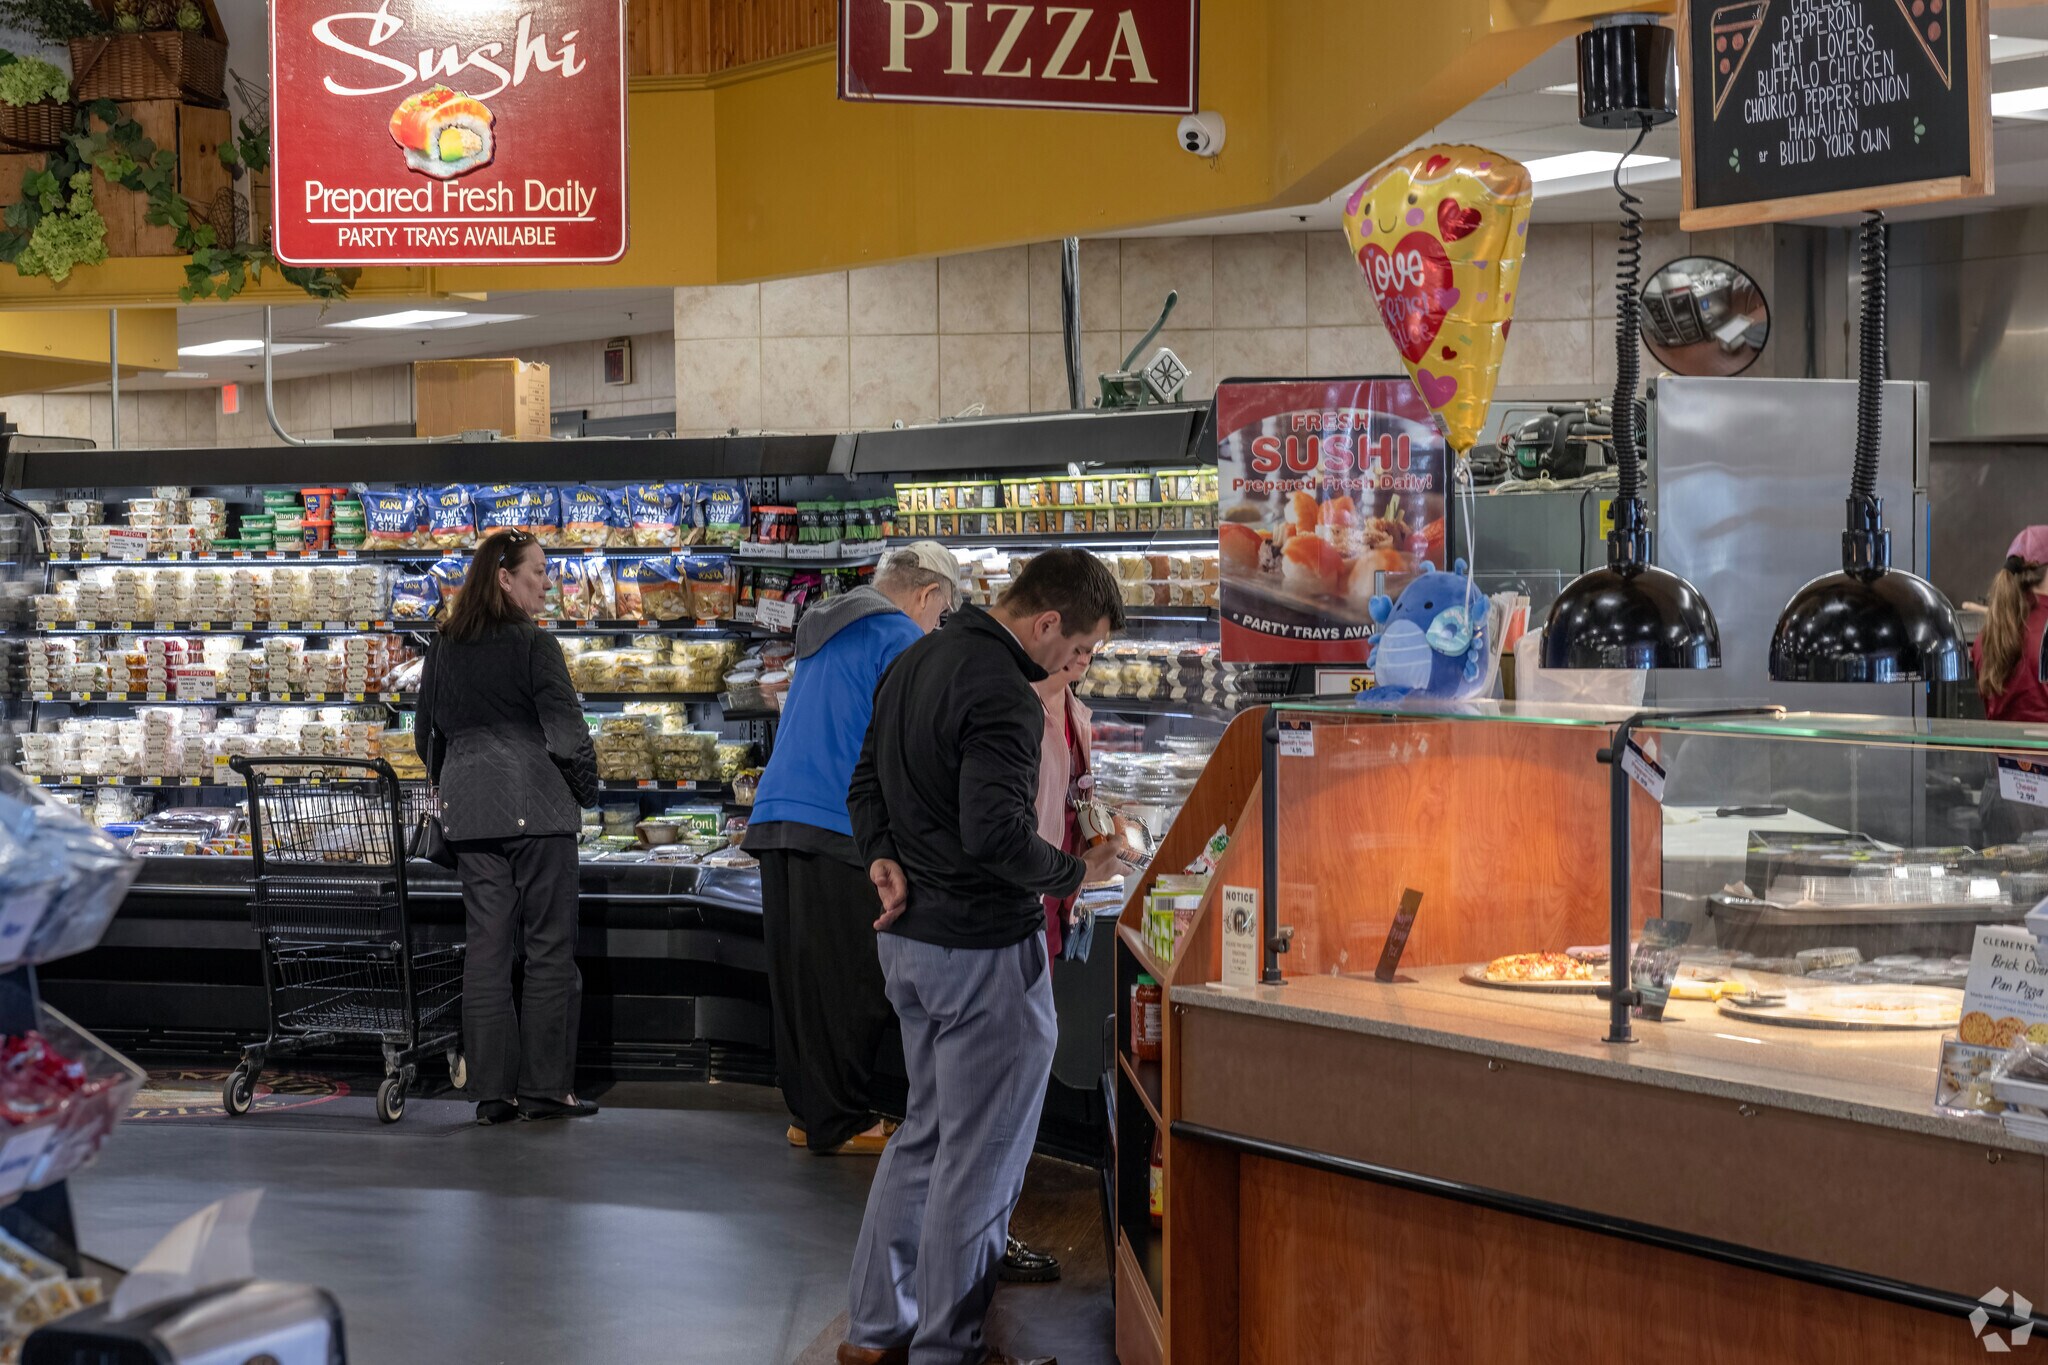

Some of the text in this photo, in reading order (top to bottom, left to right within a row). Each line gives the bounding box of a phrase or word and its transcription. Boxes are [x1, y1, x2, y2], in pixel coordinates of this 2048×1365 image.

[1782, 2, 1862, 41] PEPPERONI
[311, 0, 587, 100] Sushi
[882, 0, 1158, 84] PIZZA
[1772, 24, 1875, 68] MEAT LOVERS
[1758, 49, 1895, 97] BUFFALO CHICKEN
[1744, 91, 1797, 124] CHOURICO
[1805, 84, 1853, 115] PEPPER
[1863, 73, 1910, 107] ONION
[1789, 108, 1859, 141] HAWAIIAN
[1780, 139, 1816, 167] BUILD
[1822, 132, 1855, 159] YOUR
[1861, 126, 1891, 154] OWN
[305, 179, 597, 220] Prepared Fresh Daily
[338, 227, 556, 247] PARTY TRAYS AVAILABLE
[1366, 249, 1425, 301] Love
[1292, 412, 1370, 432] FRESH
[1251, 434, 1412, 473] SUSHI
[1232, 473, 1433, 495] Prepared Fresh Daily!
[380, 500, 402, 510] RANA
[496, 498, 518, 508] RANA
[576, 493, 597, 502] RANA
[712, 492, 731, 501] RANA
[372, 512, 409, 523] FAMILY
[568, 505, 604, 515] FAMILY
[573, 514, 594, 522] SIZE
[642, 514, 665, 523] SIZE
[706, 504, 739, 514] FAMILY
[710, 513, 730, 523] SIZE
[378, 523, 401, 532] SIZE
[442, 517, 462, 528] SIZE
[495, 517, 519, 526] SIZE
[1242, 615, 1289, 636] PARTY
[1293, 625, 1340, 639] TRAYS
[1225, 891, 1254, 903] NOTICE
[1991, 953, 2019, 971] Brick
[1991, 975, 2044, 1001] Pan Pizza
